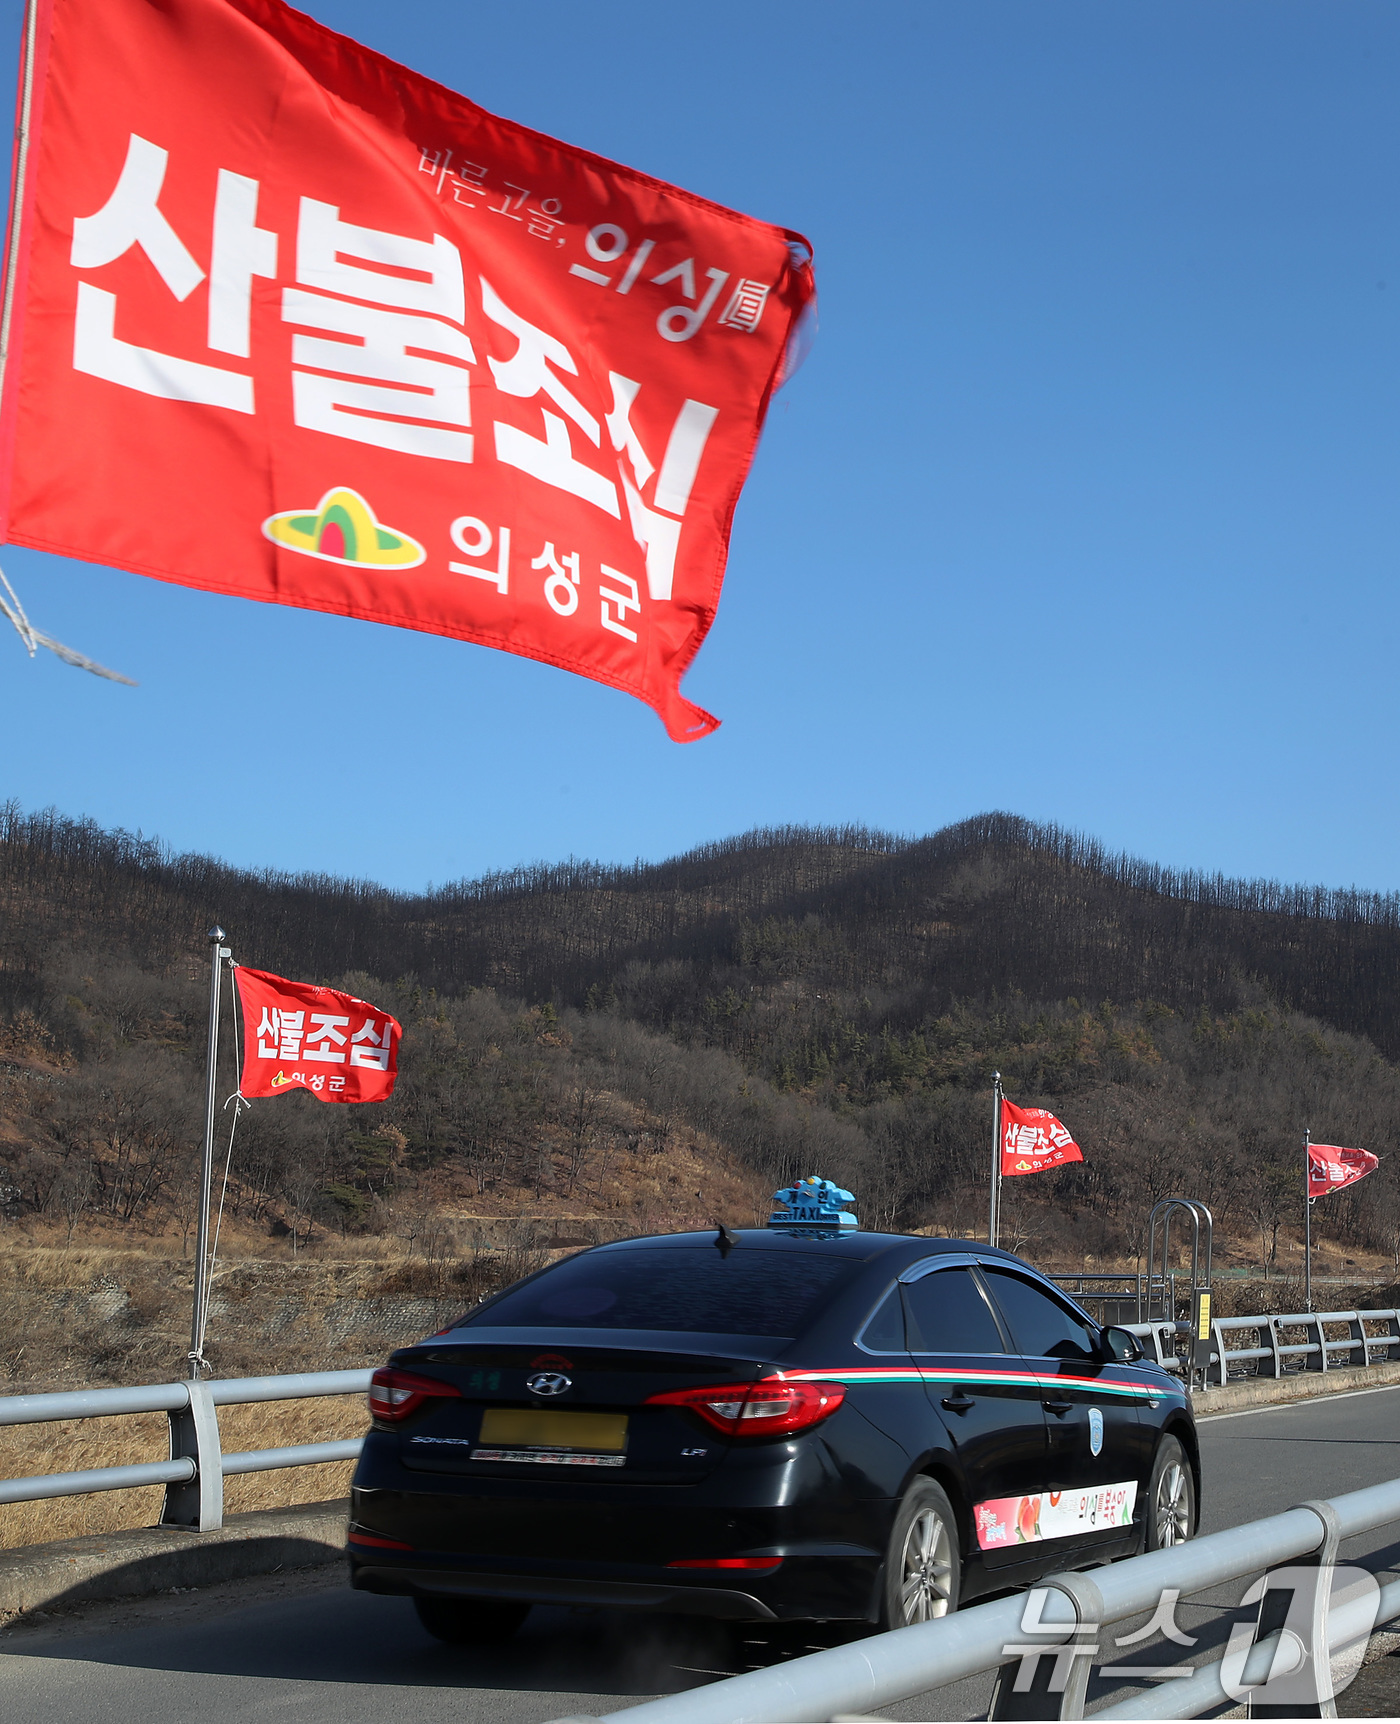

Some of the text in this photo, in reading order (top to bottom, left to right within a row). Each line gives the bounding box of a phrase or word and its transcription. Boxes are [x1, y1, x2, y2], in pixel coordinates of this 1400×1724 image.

[449, 516, 643, 643] 의성군
[257, 1006, 394, 1071] 산불조심
[291, 1072, 346, 1092] 의성군
[1005, 1122, 1074, 1155] 산불조심
[793, 1207, 820, 1220] TAXI
[409, 1435, 469, 1446] SONATA
